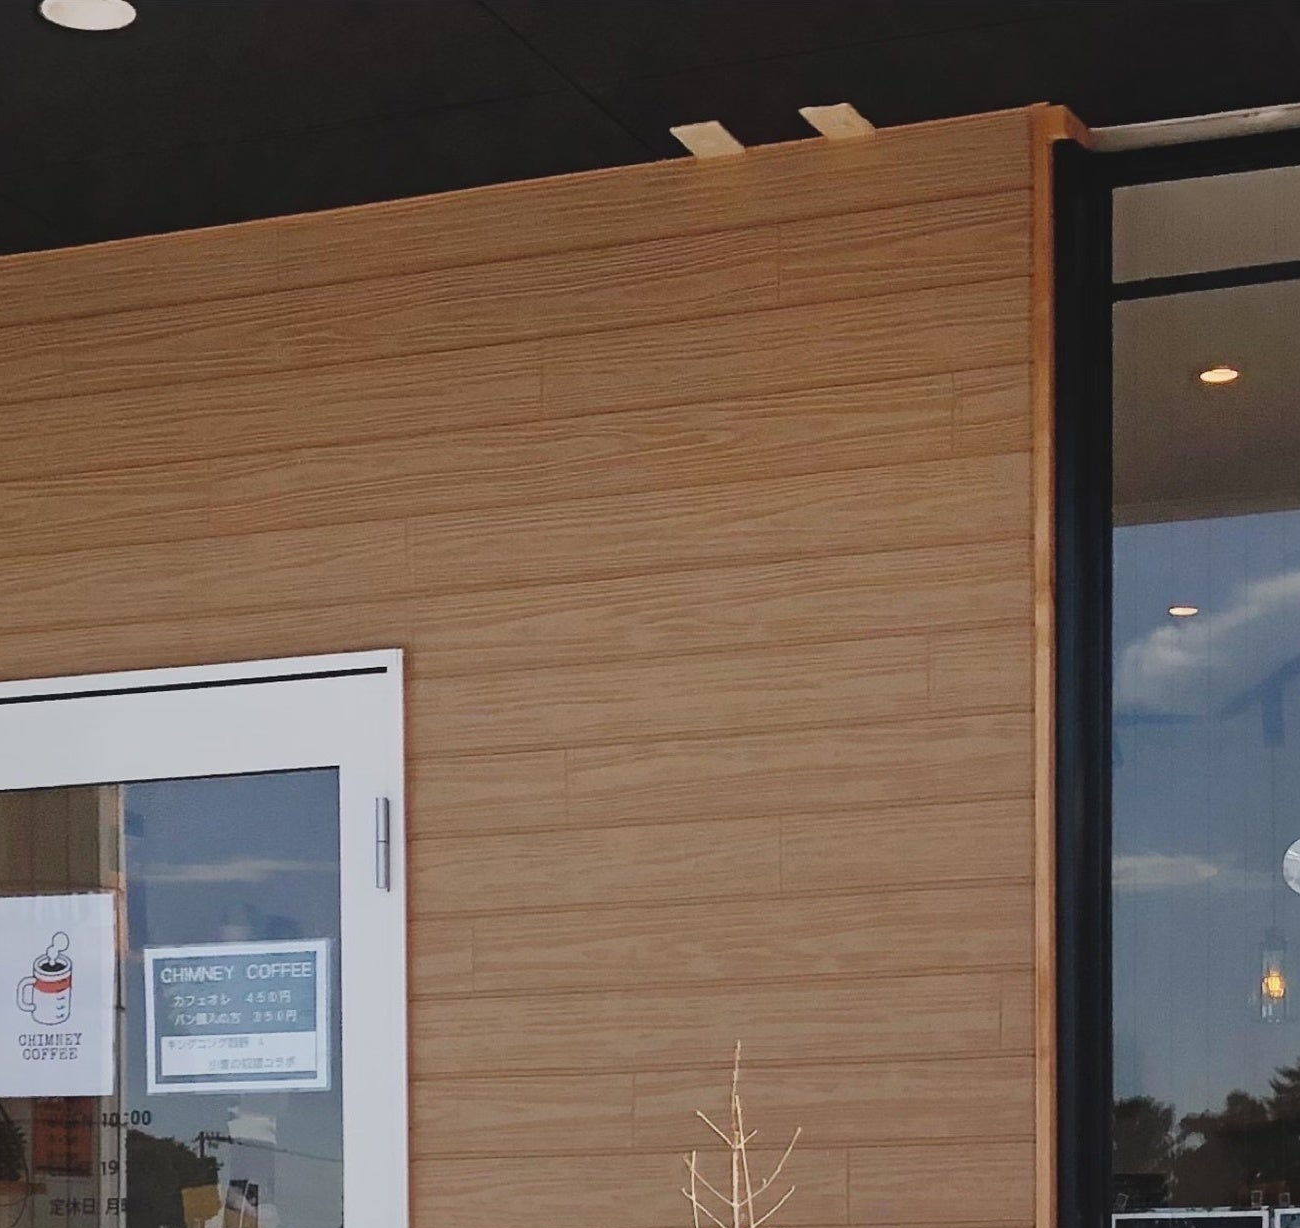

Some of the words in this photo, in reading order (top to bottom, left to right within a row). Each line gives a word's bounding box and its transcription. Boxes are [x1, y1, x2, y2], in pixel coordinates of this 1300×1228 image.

[160, 966, 235, 984] CHIMNEY
[246, 962, 312, 980] COFFEE
[18, 1033, 83, 1047] CHIMNEY
[22, 1047, 78, 1061] COFFEE
[102, 1110, 152, 1126] 10:00
